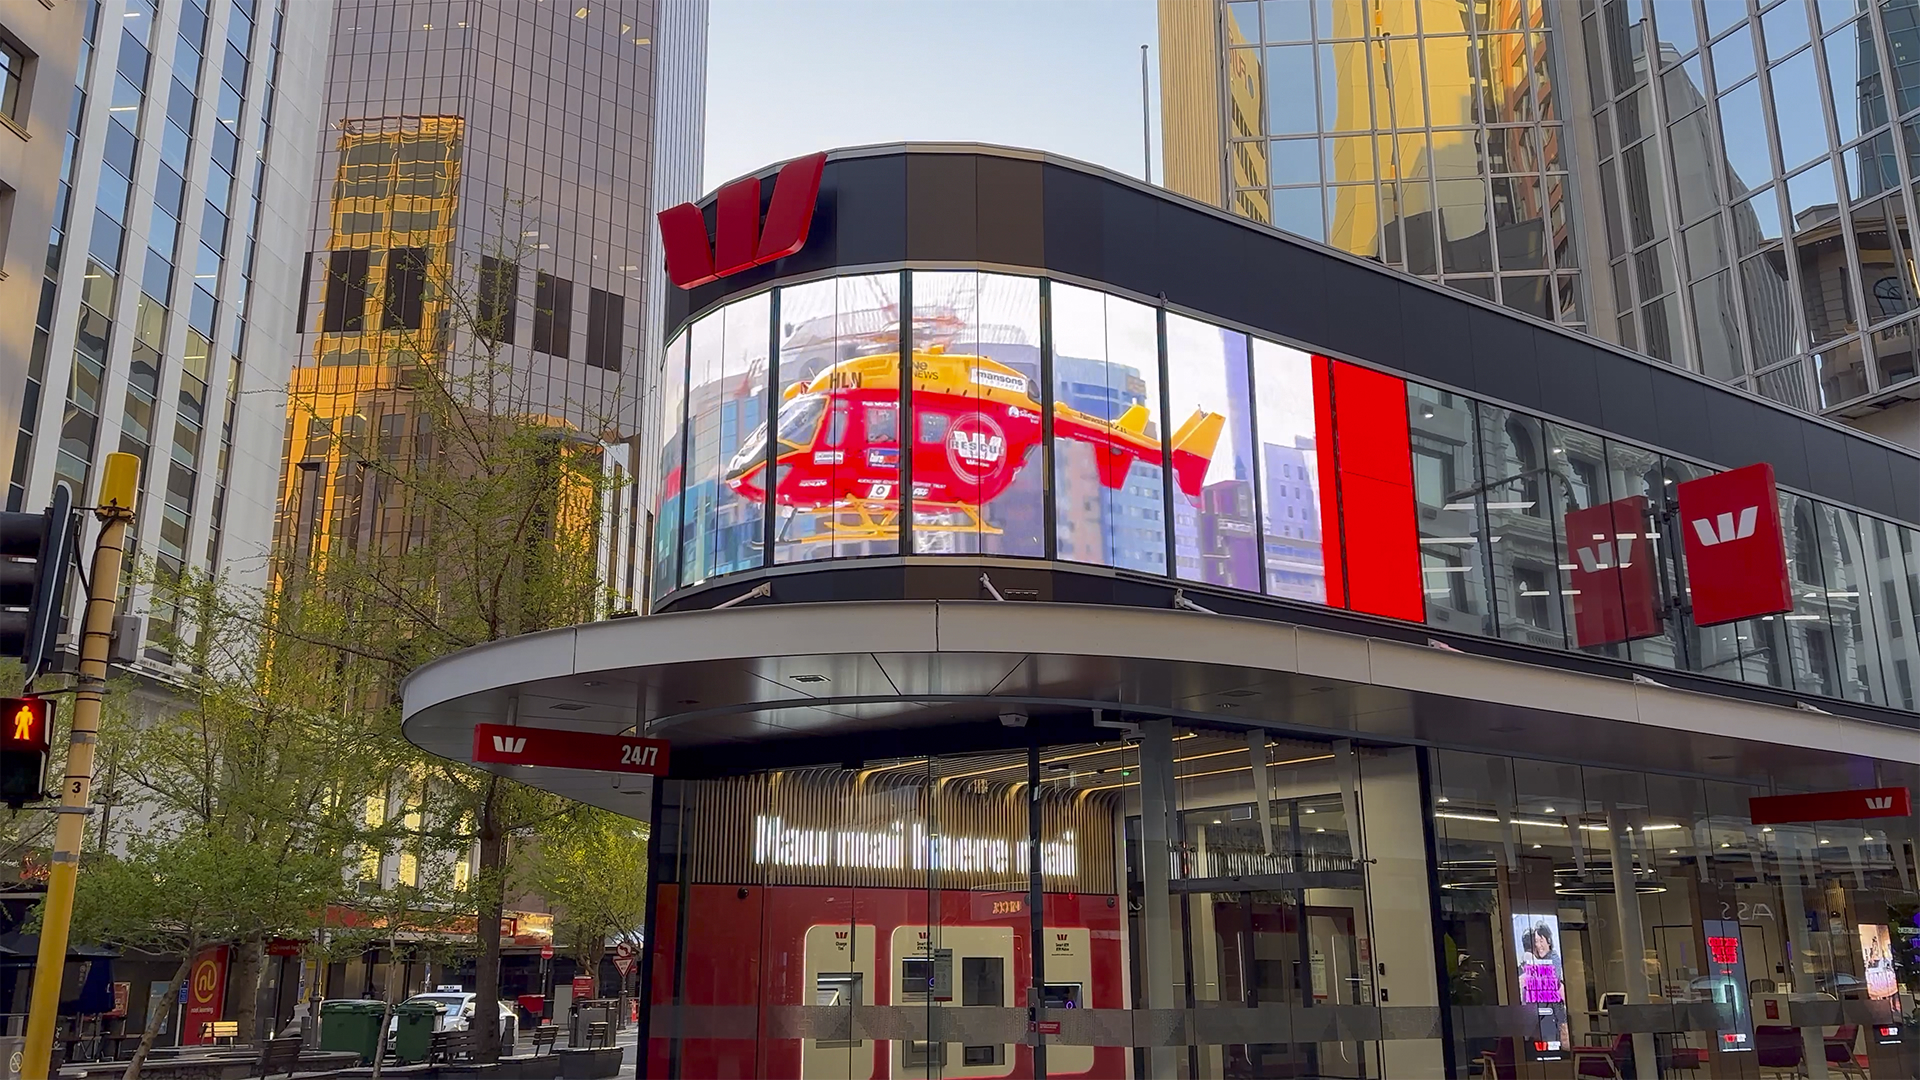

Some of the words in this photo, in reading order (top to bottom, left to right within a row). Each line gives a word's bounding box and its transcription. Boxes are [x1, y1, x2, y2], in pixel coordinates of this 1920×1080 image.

[830, 371, 862, 389] HLN
[977, 370, 1024, 386] mansons
[620, 744, 659, 767] 24/7
[72, 781, 81, 793] 3
